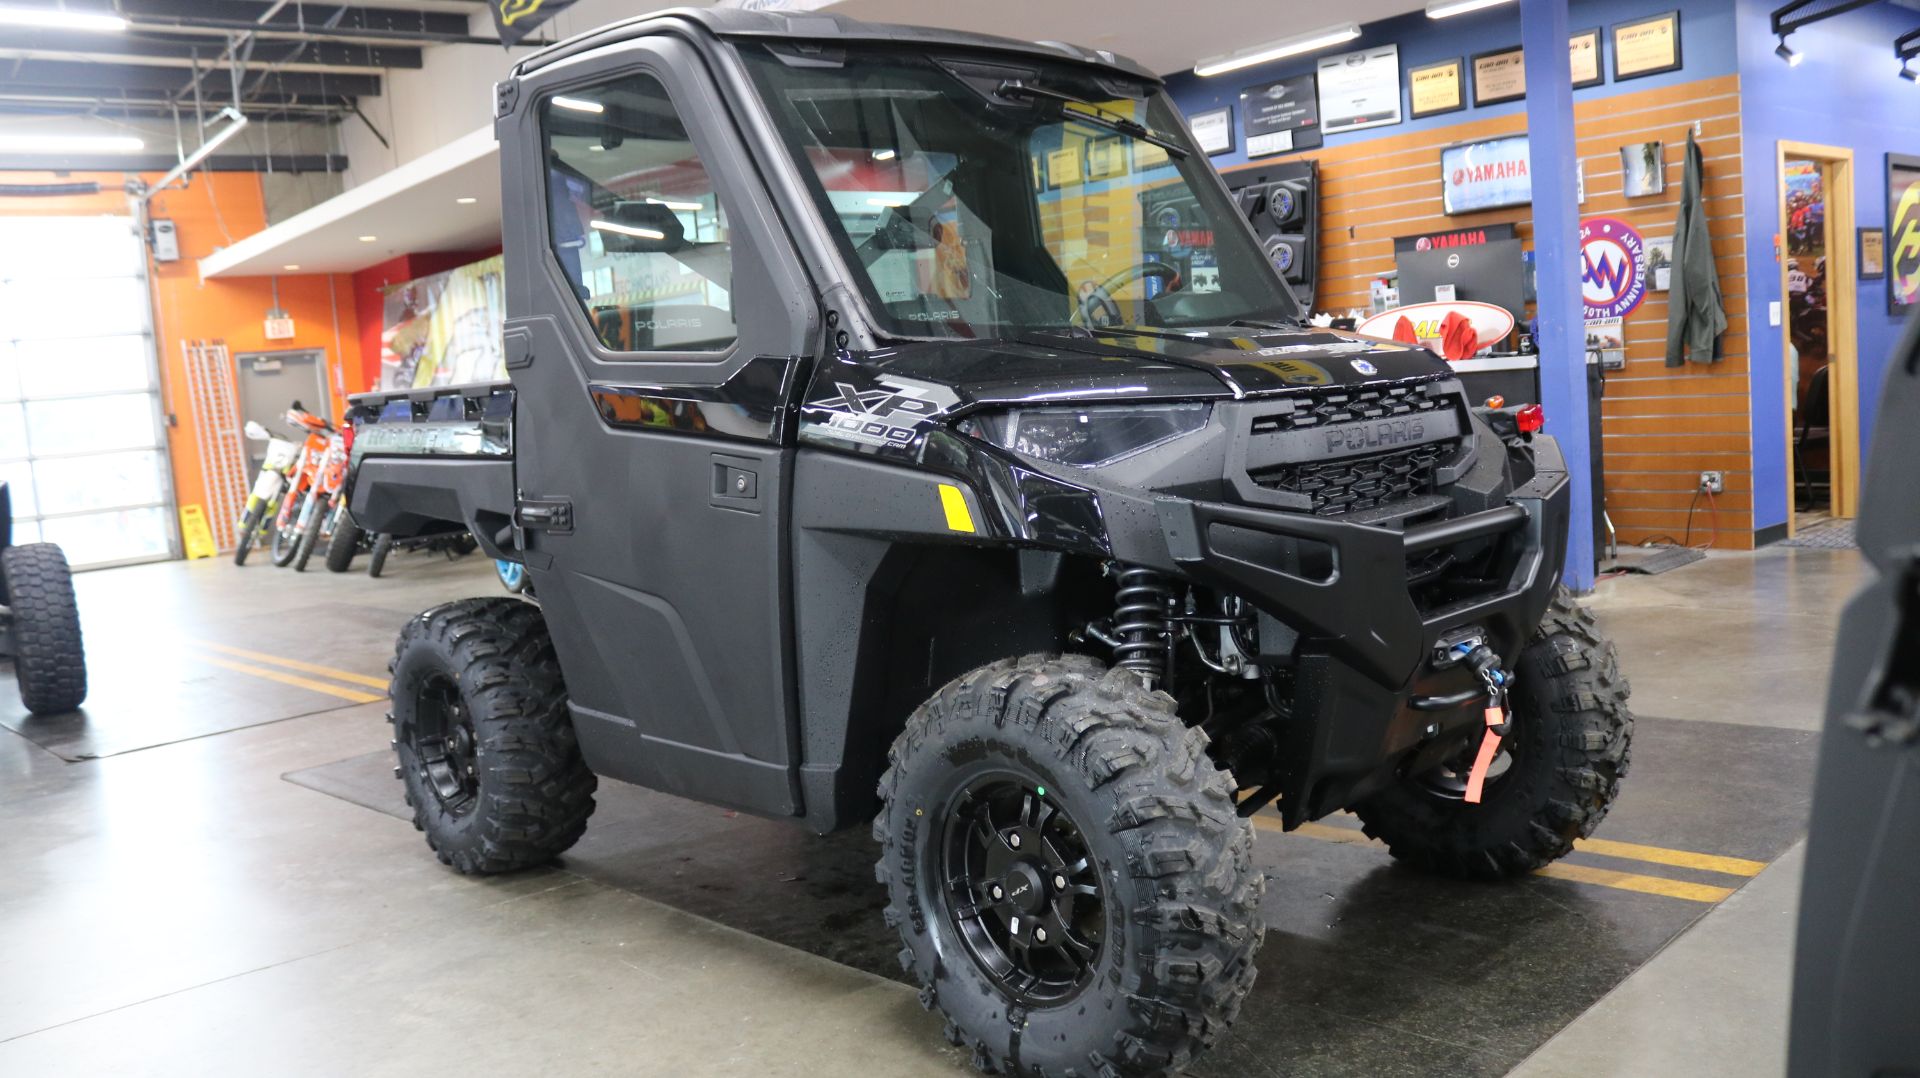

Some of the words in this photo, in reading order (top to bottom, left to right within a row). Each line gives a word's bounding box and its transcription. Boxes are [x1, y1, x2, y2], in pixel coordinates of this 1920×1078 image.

[1466, 159, 1528, 183] YAMAHA
[1432, 230, 1487, 250] YAMAHA
[1614, 232, 1646, 315] ANNIVERSARY
[634, 318, 702, 332] POLARIS
[909, 310, 960, 322] POLARIS
[807, 382, 942, 418] XP
[828, 412, 917, 444] 1000
[1325, 416, 1425, 453] POLARIS
[887, 440, 907, 449] CAM
[1011, 883, 1029, 897] XP
